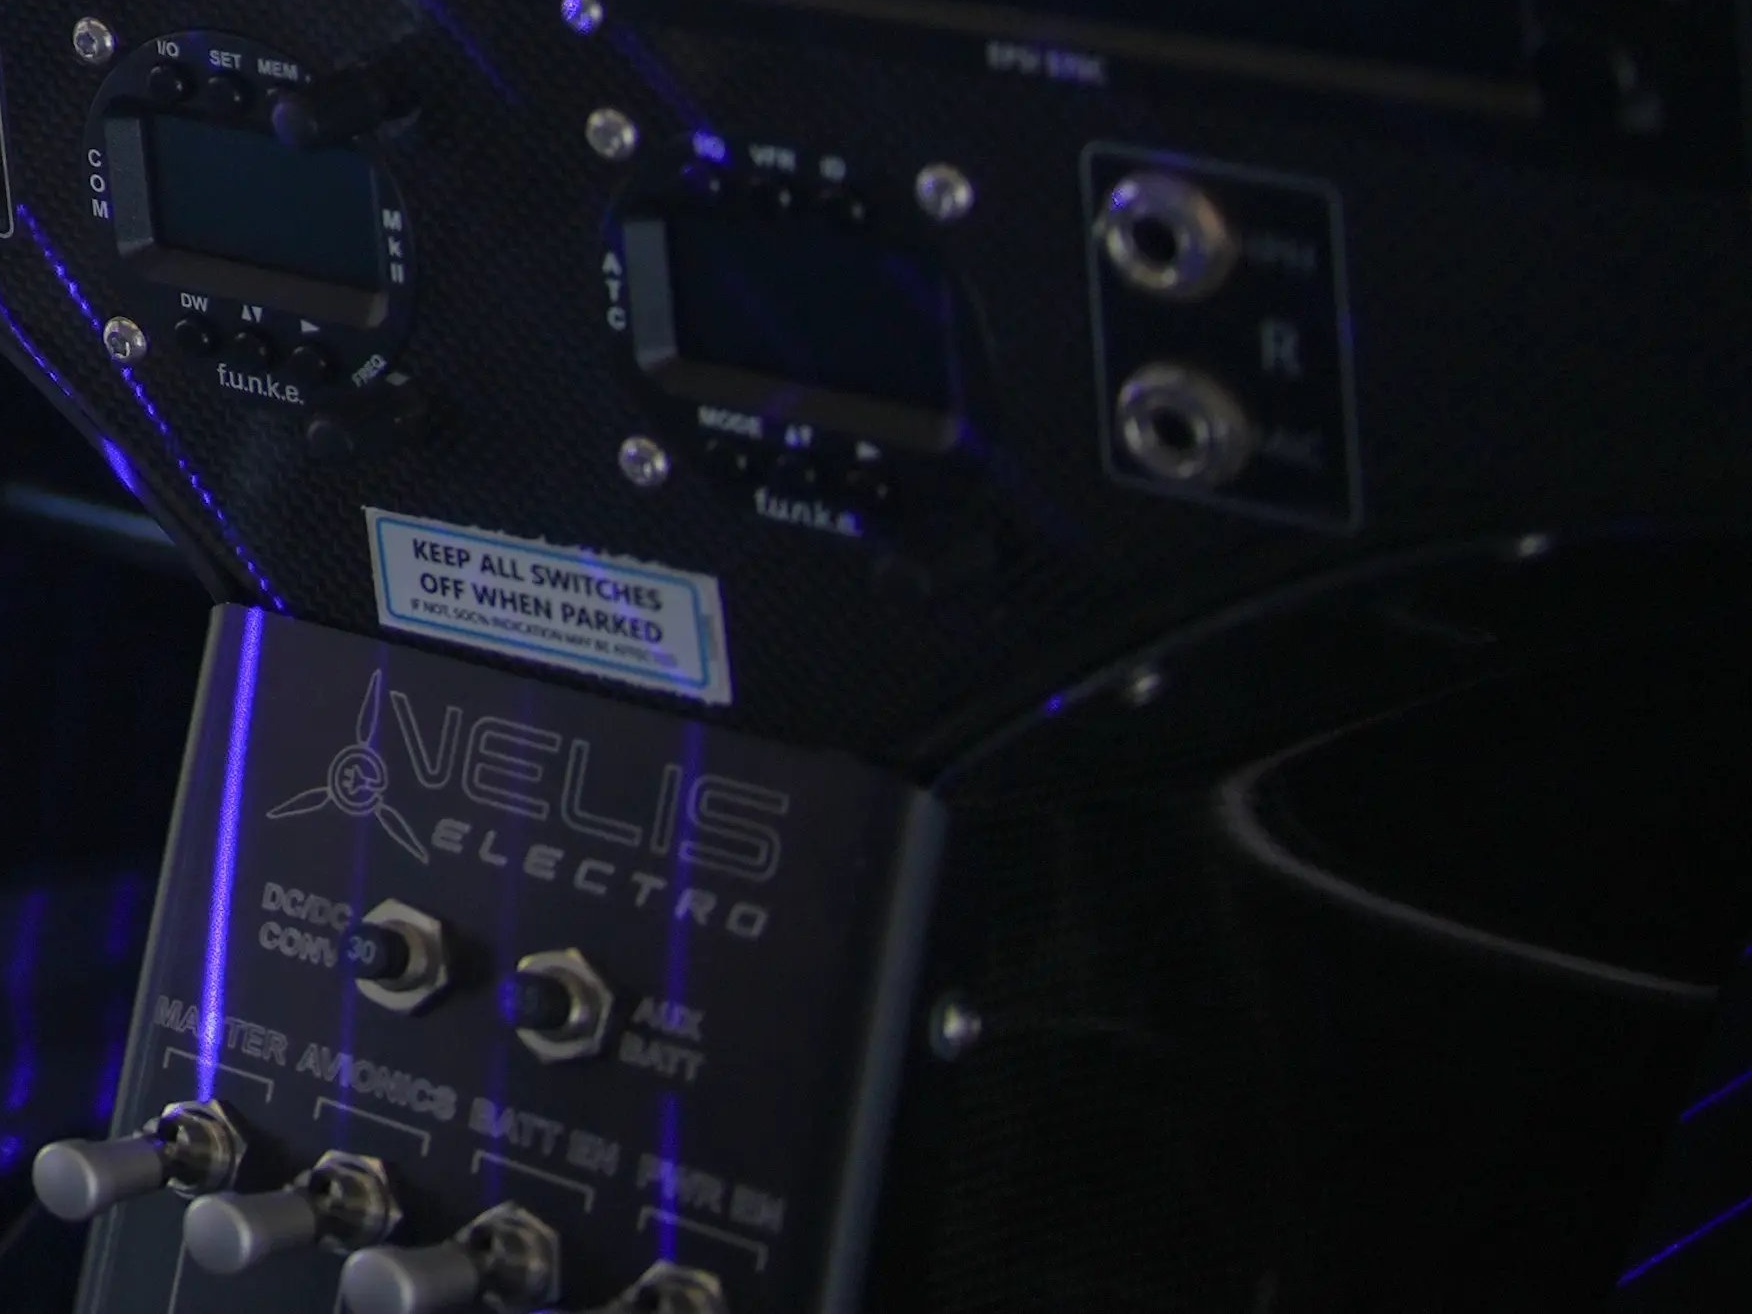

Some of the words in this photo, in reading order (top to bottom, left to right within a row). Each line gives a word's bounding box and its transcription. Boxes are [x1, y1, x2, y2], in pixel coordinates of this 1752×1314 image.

[208, 49, 242, 69] SET
[257, 58, 299, 82] MEM
[180, 291, 209, 313] DW
[412, 538, 471, 570] KEEP
[480, 553, 524, 582] ALL
[530, 563, 664, 612] SWITCHES
[420, 572, 465, 600] OFF
[471, 582, 552, 620] WHEN
[561, 602, 664, 645] PARKED
[389, 689, 790, 884] VELIS
[260, 881, 353, 932] DC/DC
[429, 816, 771, 941] ELECTRO
[346, 933, 379, 967] 30
[154, 994, 289, 1068] MATER
[631, 995, 705, 1044] AUX
[295, 1039, 459, 1123] AVIONICS
[616, 1033, 707, 1084] BATT
[468, 1095, 563, 1160] BATT
